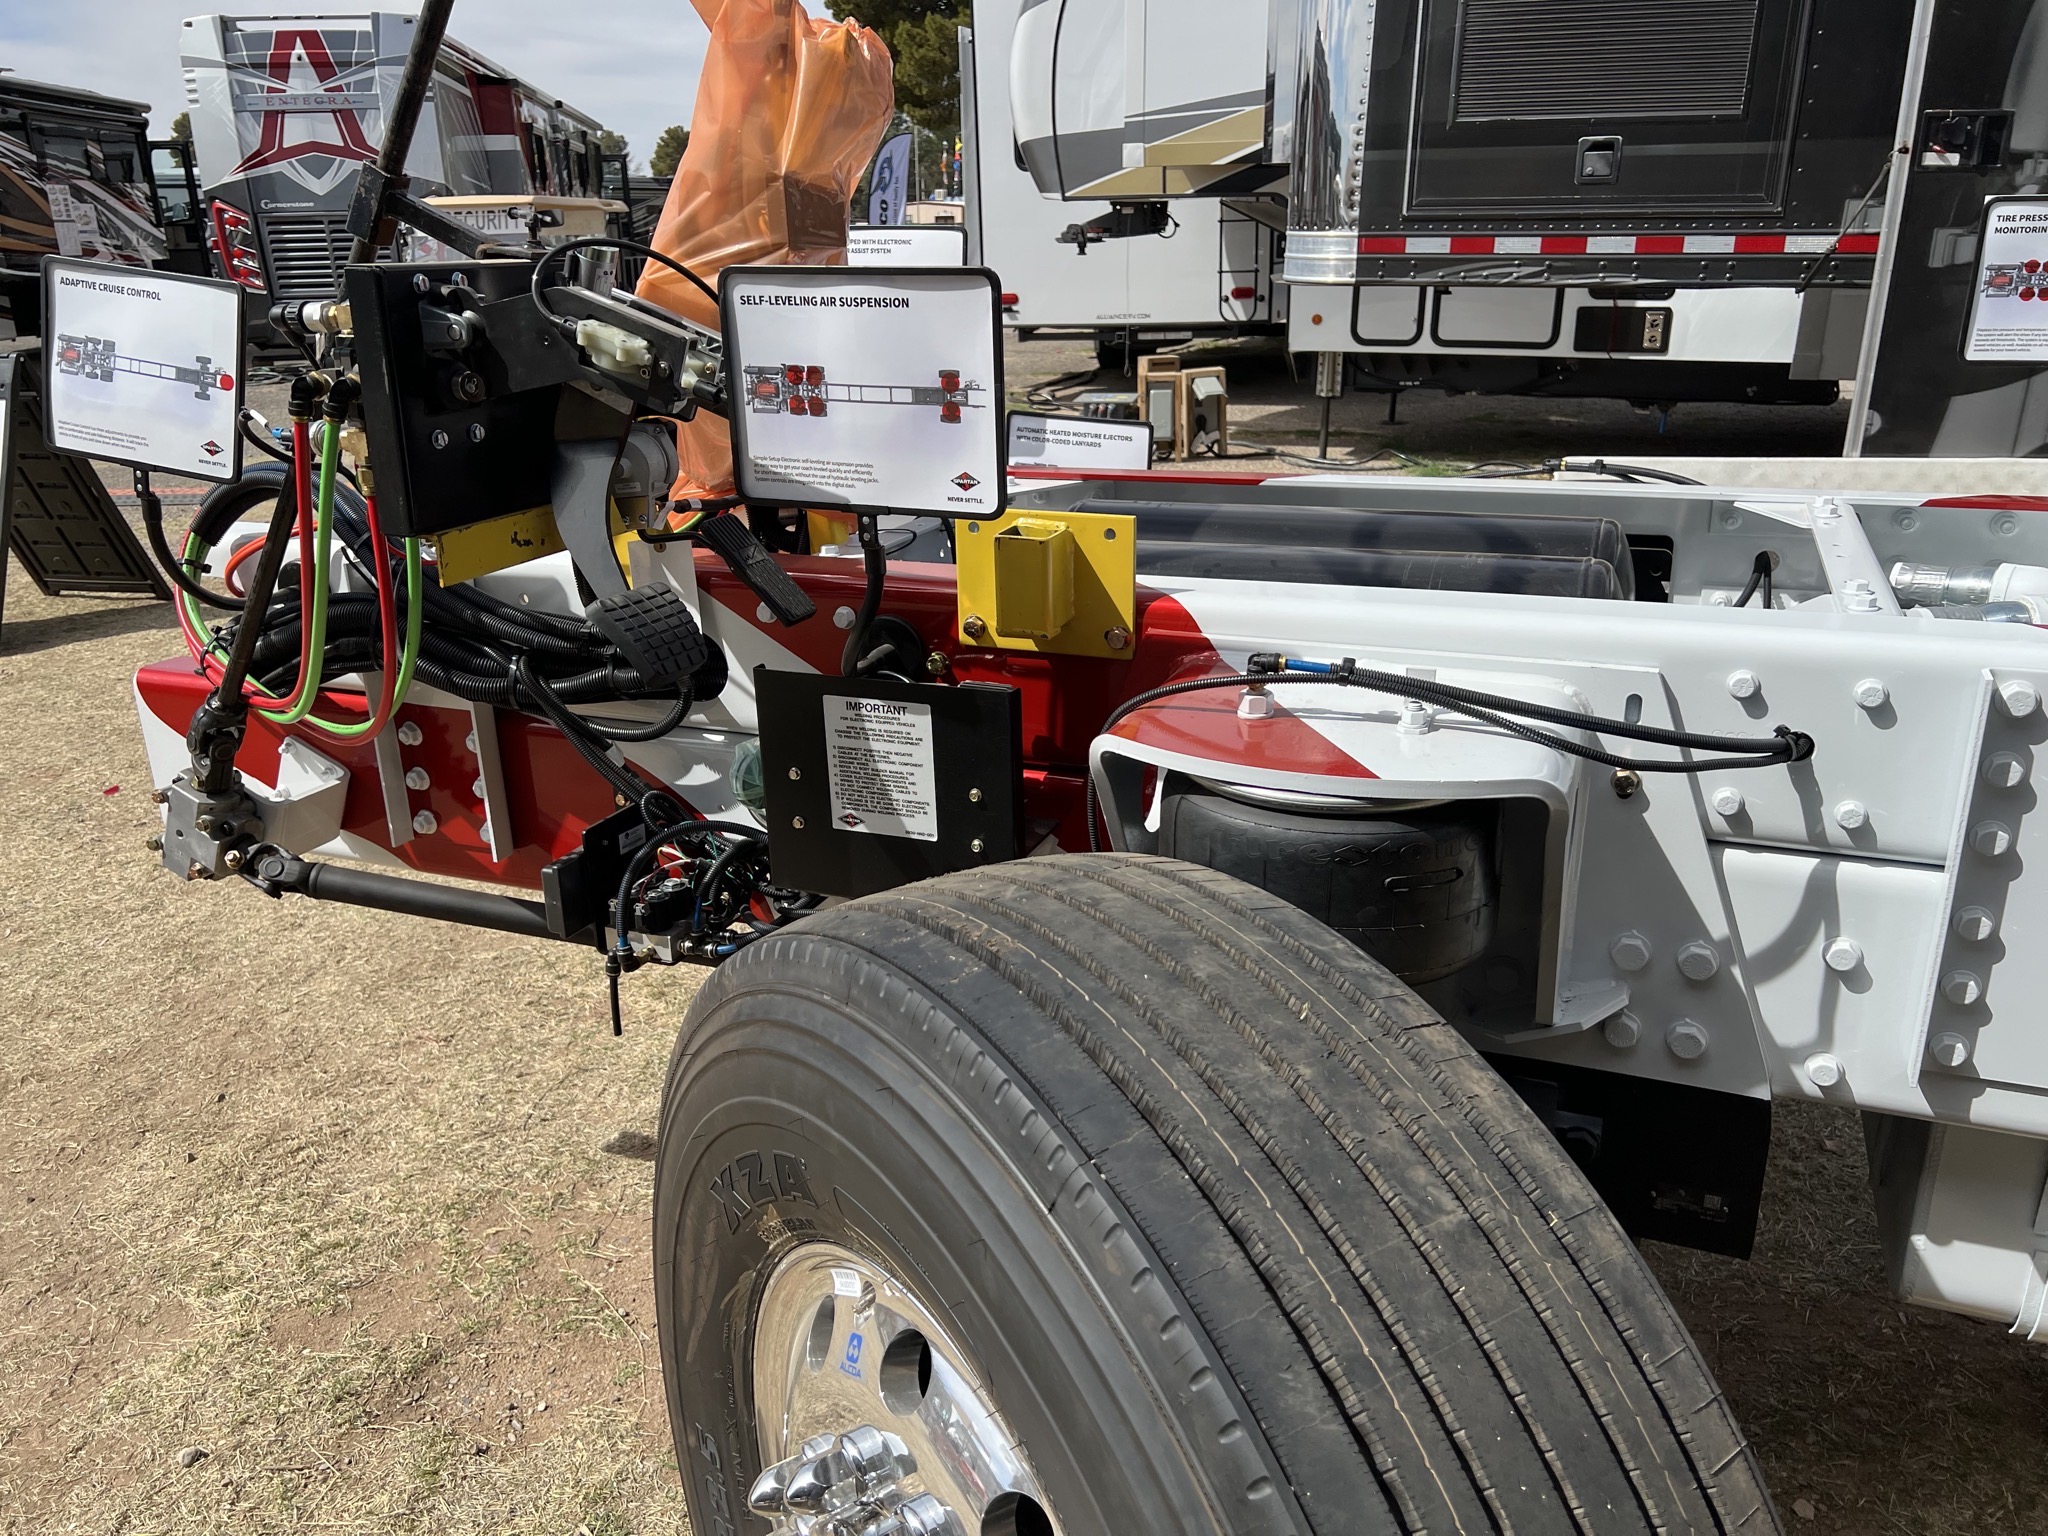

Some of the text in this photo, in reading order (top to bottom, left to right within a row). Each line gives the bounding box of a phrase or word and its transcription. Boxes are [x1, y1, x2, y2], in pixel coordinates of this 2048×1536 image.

[265, 96, 353, 107] ENTEGRA
[260, 199, 315, 210] Cornerstone
[446, 209, 520, 230] ECURIT
[1996, 213, 2048, 223] TIRE PRESS
[1994, 225, 2048, 235] MONITORIN
[60, 276, 162, 301] ADAPTIVE CRUISE CONTROL
[739, 294, 910, 309] SELF-LEVELING AIR SUSPENSION
[1016, 426, 1133, 442] AUTOMATIC HEATED MOISTURE EJECTORS
[1031, 436, 1071, 446] COLOR-CODED
[1071, 439, 1102, 448] LANYARDS
[846, 701, 907, 716] IMPORTANT
[839, 1361, 862, 1379] ALCOA
